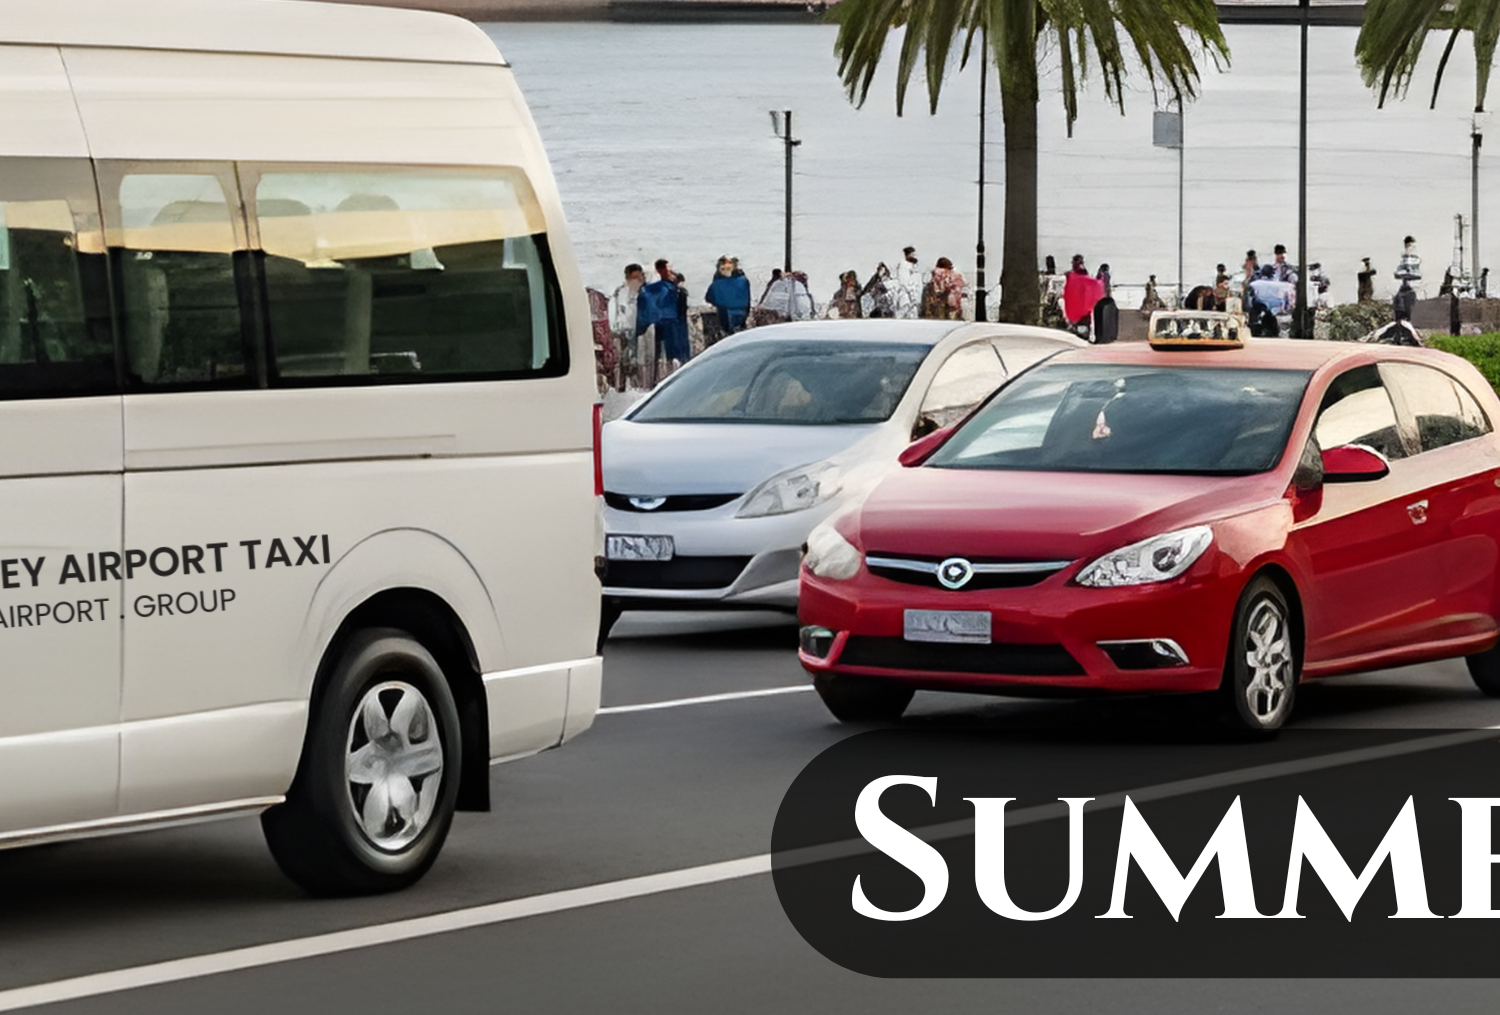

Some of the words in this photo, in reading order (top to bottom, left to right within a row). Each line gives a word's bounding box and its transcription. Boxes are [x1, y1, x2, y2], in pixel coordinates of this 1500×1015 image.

[58, 542, 228, 585] AIRPORT
[239, 534, 331, 570] TAXI
[133, 588, 236, 618] GROUP
